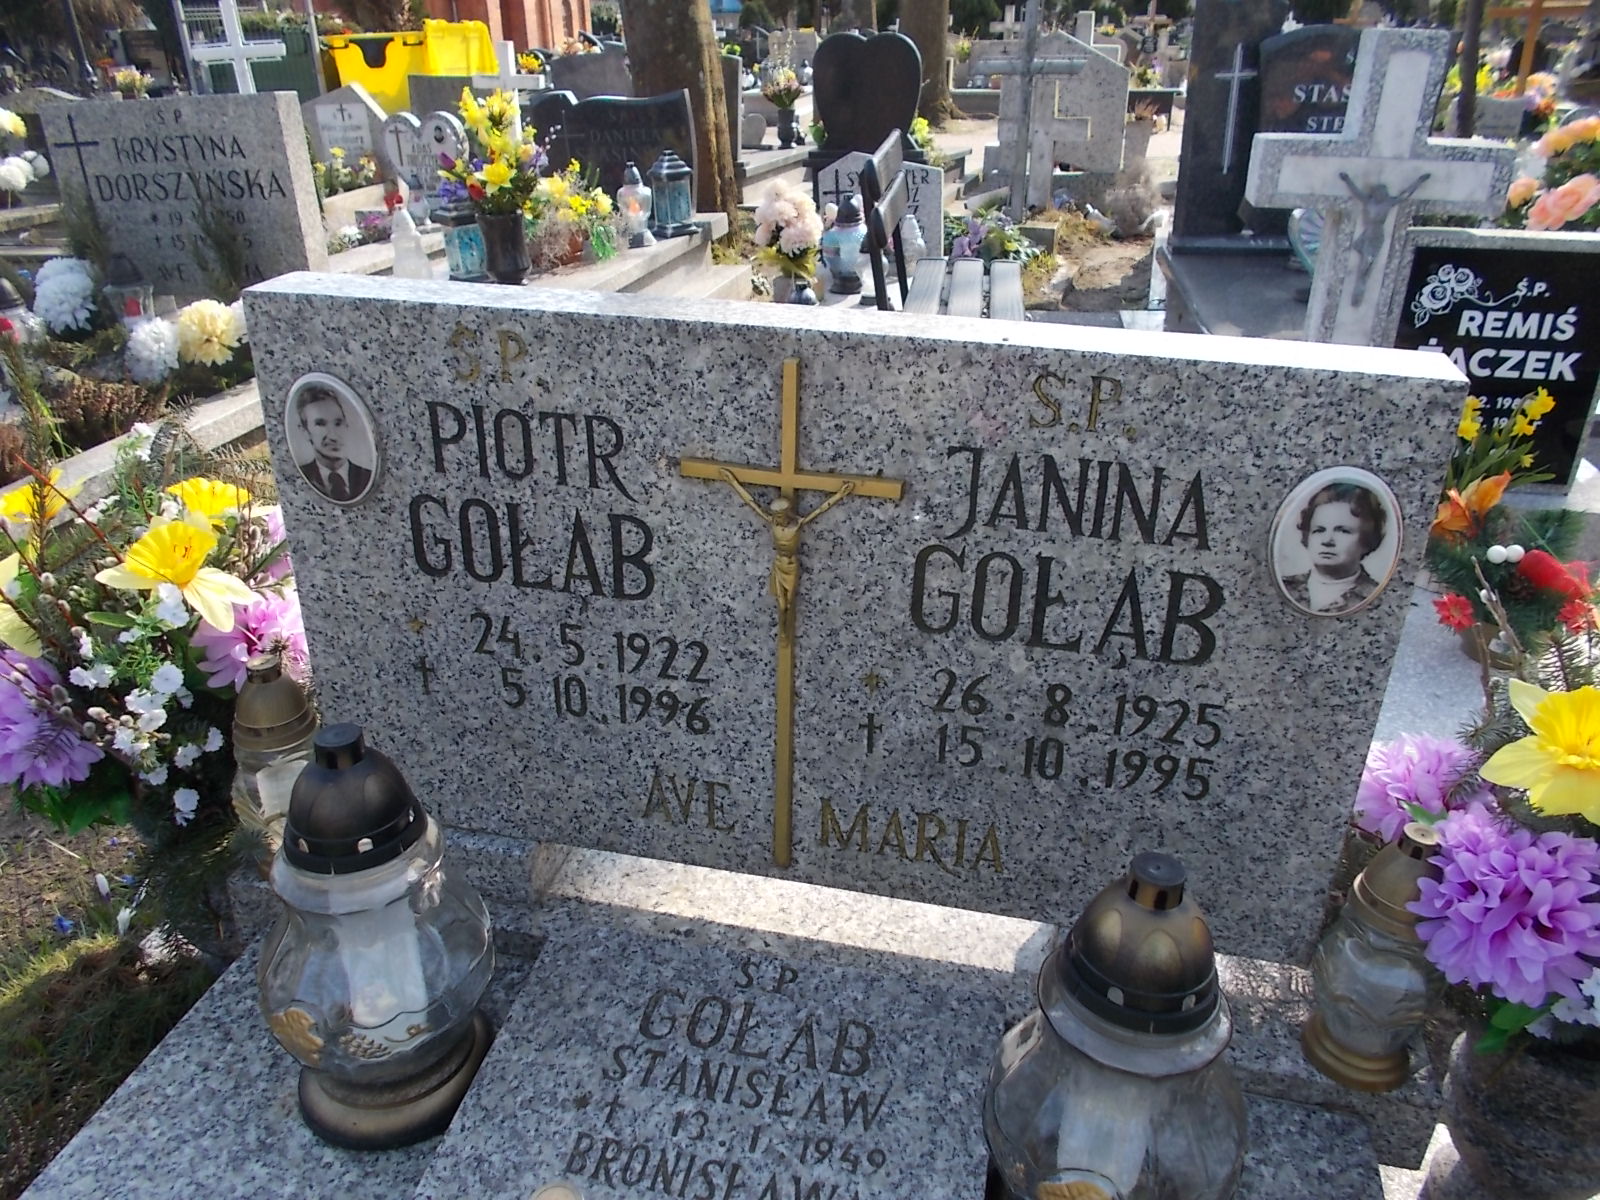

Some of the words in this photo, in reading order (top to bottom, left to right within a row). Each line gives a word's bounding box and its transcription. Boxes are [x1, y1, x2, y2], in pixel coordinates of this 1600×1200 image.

[1293, 84, 1352, 103] STAS
[113, 136, 246, 164] KRYSTYNA
[1306, 115, 1345, 132] STE
[96, 167, 287, 202] DORSZYŃSKA
[1456, 306, 1579, 342] REMIŚ
[1417, 338, 1582, 382] ACZEK
[425, 400, 639, 503] PIOTR
[944, 446, 1211, 552] JANINA
[911, 544, 1227, 670] GOŁĄB
[612, 631, 711, 685] 1922
[615, 683, 712, 736] 1996
[1113, 694, 1225, 749] 1925
[1104, 748, 1215, 802] 1995
[640, 765, 736, 833] AVE
[817, 796, 1005, 879] MARIA
[602, 1044, 890, 1131] STANISŁAW
